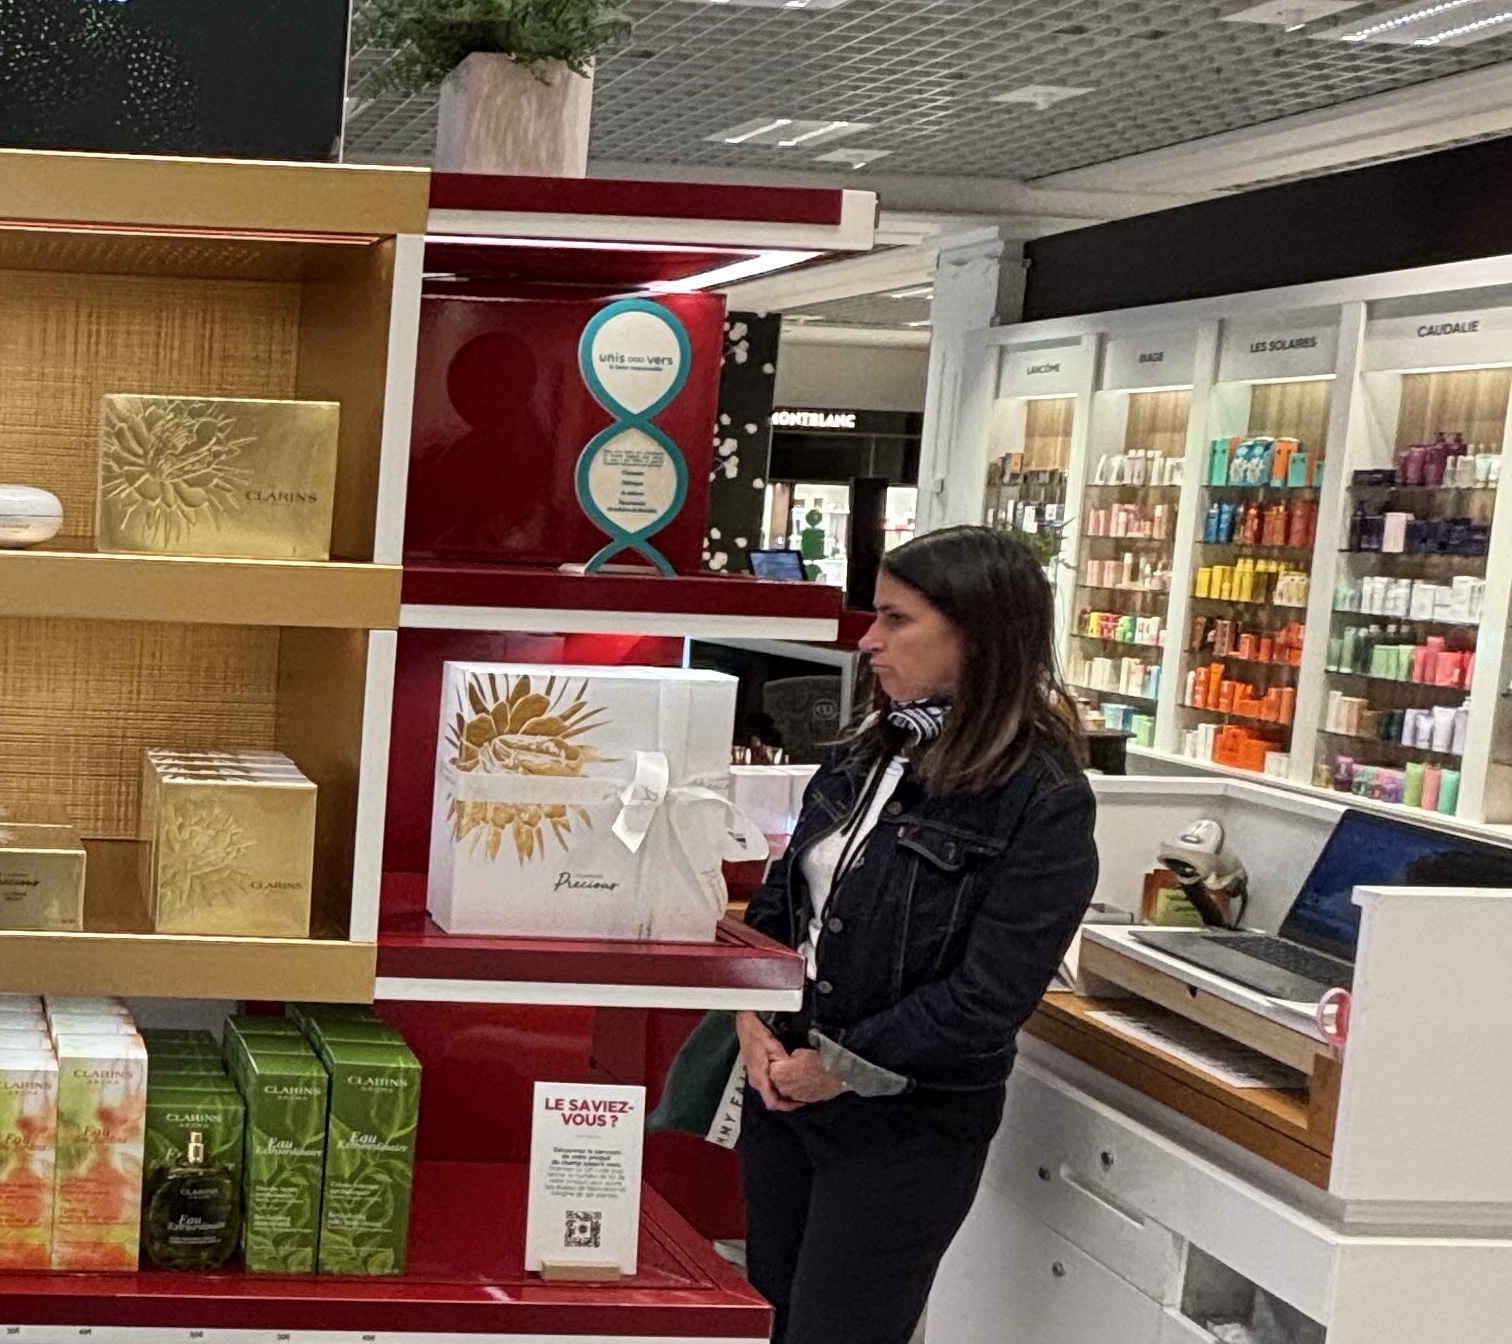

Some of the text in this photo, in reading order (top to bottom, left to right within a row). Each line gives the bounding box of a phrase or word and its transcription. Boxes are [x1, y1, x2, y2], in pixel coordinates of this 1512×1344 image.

[1417, 320, 1480, 338] CAUDALIE
[245, 490, 318, 504] CLARINS
[554, 872, 619, 891] Precious
[347, 1076, 408, 1088] CLARINS
[264, 1085, 322, 1096] CLARINS
[544, 1097, 635, 1114] LE SAVIEZ-
[561, 1113, 619, 1127] VOUS ?
[349, 1131, 377, 1144] Eau
